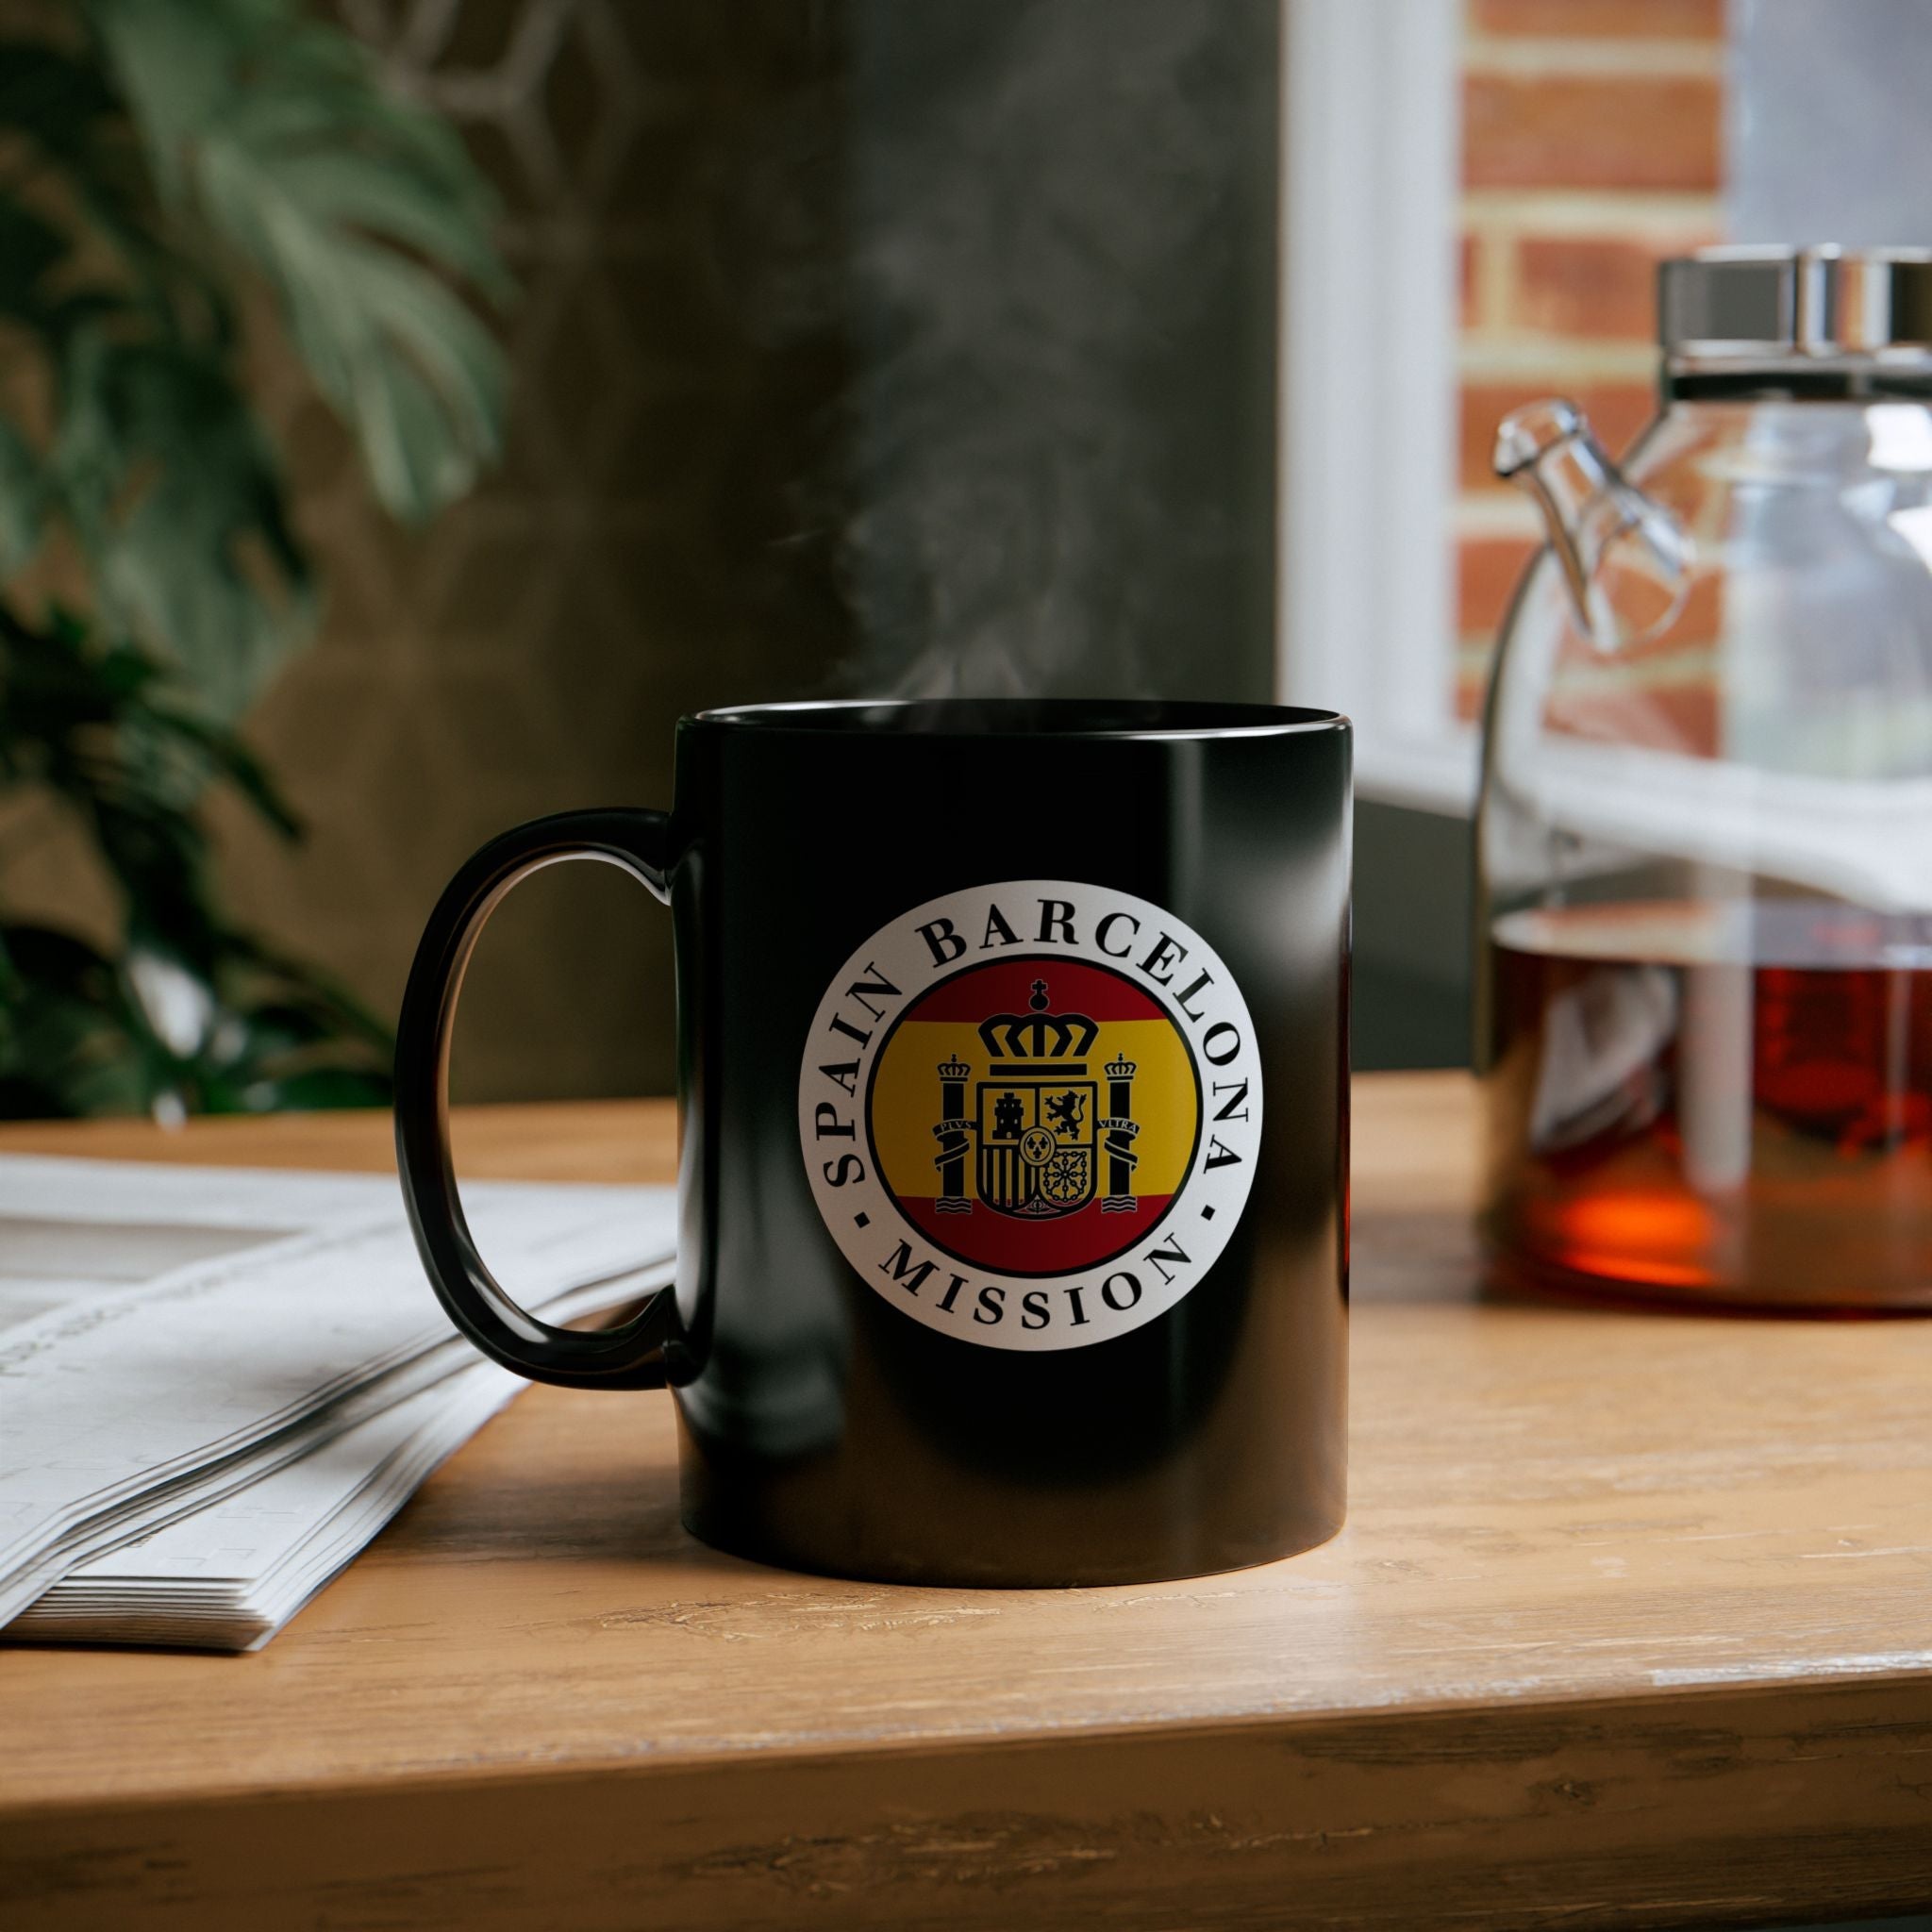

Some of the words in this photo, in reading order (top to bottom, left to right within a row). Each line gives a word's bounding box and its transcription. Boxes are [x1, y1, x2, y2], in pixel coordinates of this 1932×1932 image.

[815, 961, 904, 1189] SPAIN
[914, 899, 1249, 1175] BARCELONA
[878, 1232, 1192, 1330] MISSION
